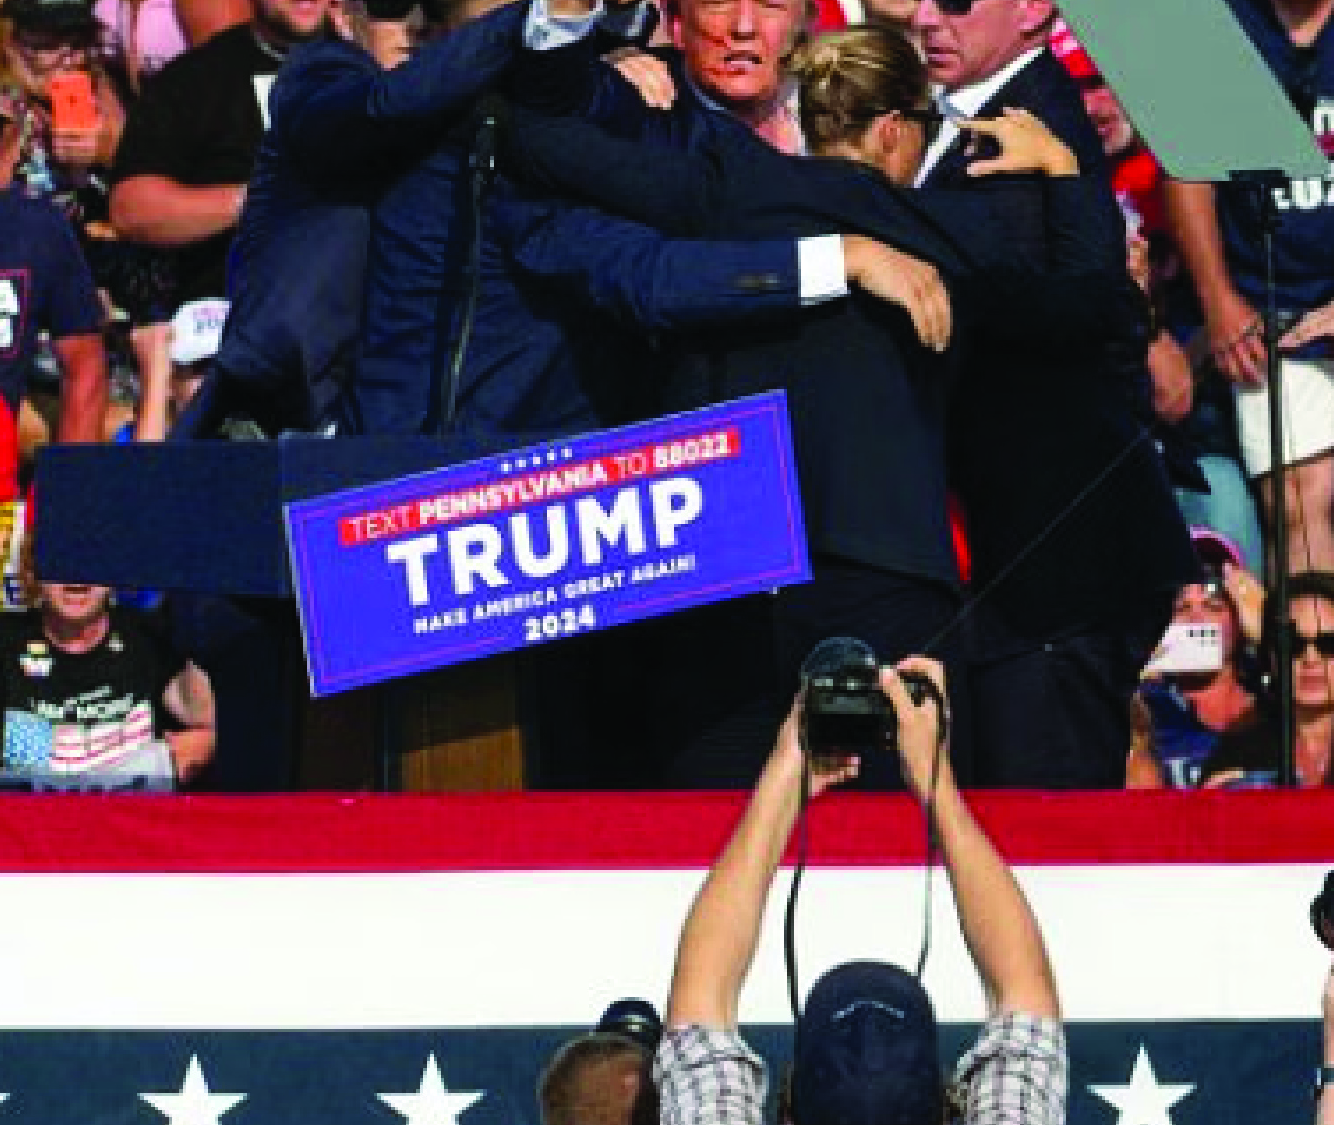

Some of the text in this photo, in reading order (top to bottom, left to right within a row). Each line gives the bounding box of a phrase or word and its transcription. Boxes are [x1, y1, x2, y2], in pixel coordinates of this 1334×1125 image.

[349, 430, 732, 539] TEXT PENNSYLVANIA TO 88022
[386, 476, 704, 607] TRUMP
[413, 553, 697, 633] MAKE AMERICA GREAT AGAIN!
[522, 603, 596, 642] 2024
